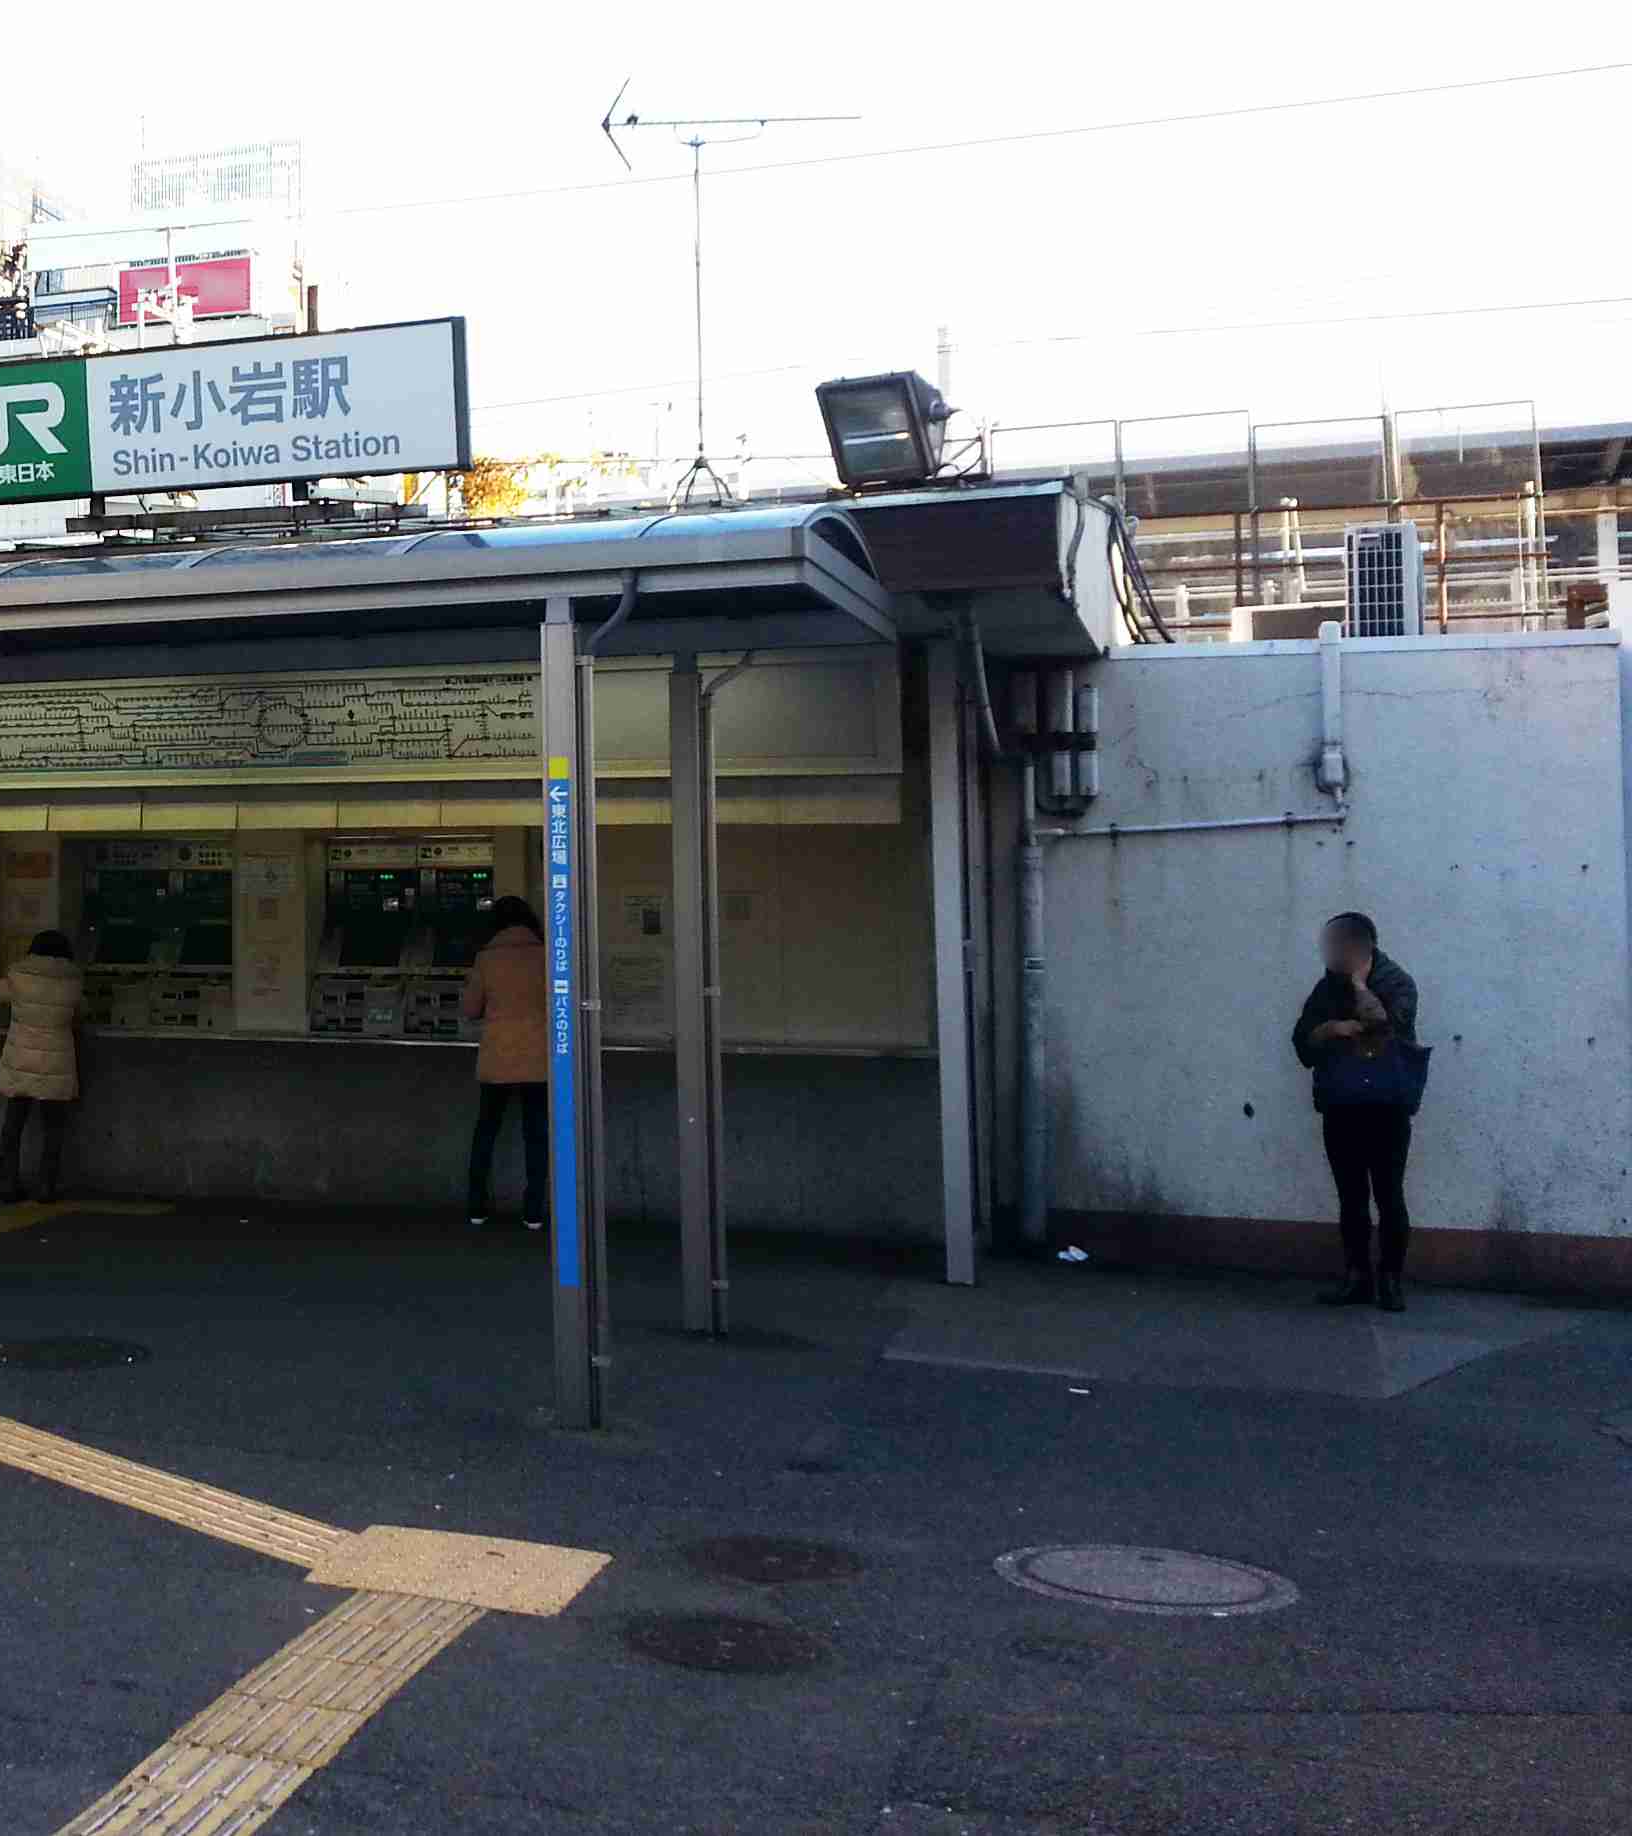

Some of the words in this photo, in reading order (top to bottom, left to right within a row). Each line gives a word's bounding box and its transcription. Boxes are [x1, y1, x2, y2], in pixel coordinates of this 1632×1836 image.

[109, 355, 352, 436] 新小岩駅
[112, 442, 281, 476] Shin-Koiwa
[291, 430, 401, 462] Station
[550, 803, 568, 865] 東北広場
[554, 890, 569, 973] タクシーのりば
[554, 994, 569, 1055] バスのりば
